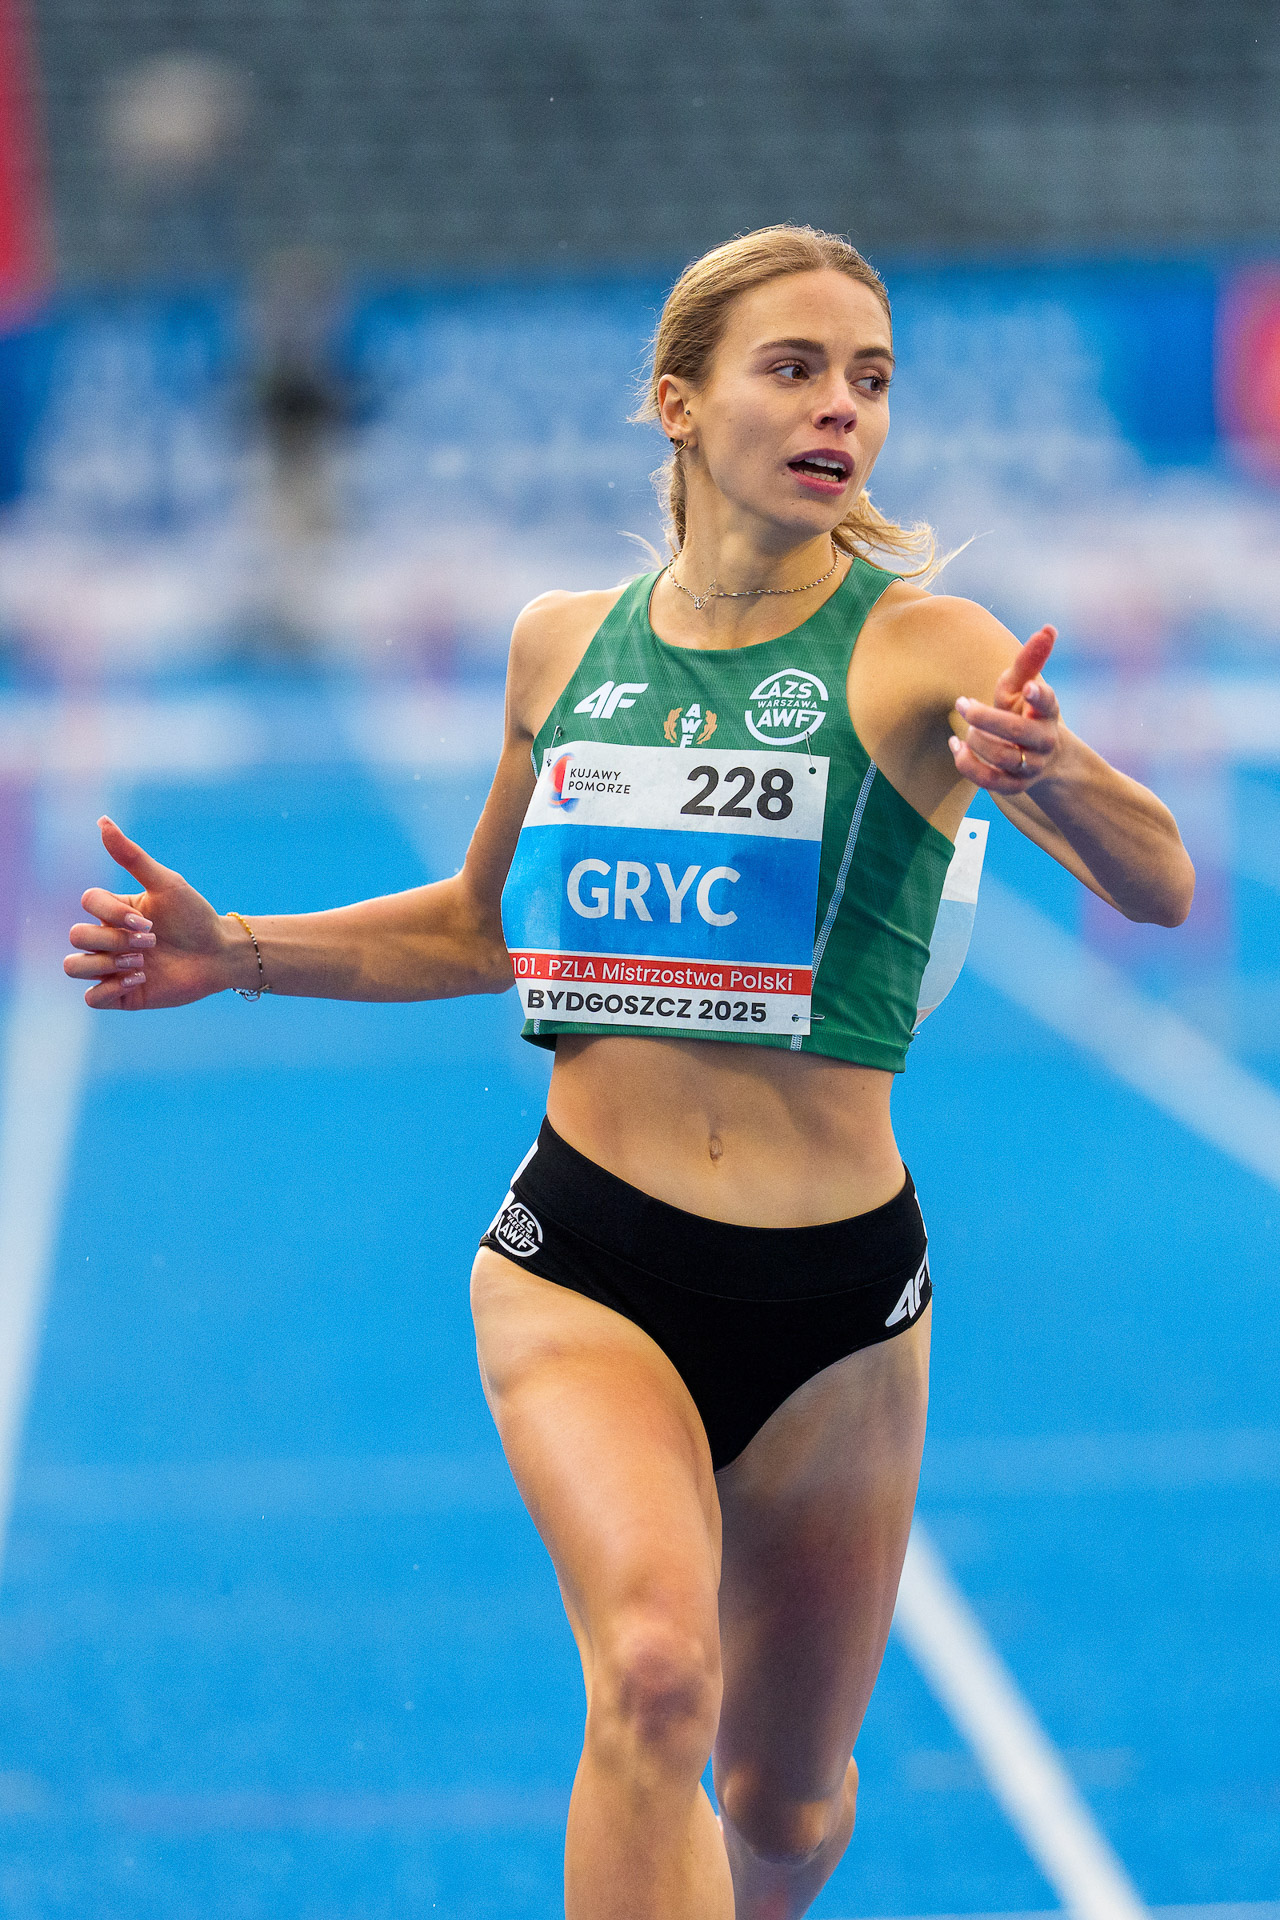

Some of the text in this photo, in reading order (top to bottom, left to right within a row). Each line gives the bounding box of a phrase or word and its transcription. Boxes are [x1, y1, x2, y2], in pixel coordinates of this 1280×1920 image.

[573, 680, 649, 719] 4F
[767, 680, 813, 699] AZS
[757, 699, 819, 710] WARSZAWA
[755, 709, 816, 729] AWF
[568, 780, 631, 795] POMORZE
[569, 768, 622, 782] KUJAWY
[680, 765, 794, 821] 228
[566, 858, 741, 927] GRYC
[512, 957, 793, 991] 101. PZLA Mistrzostwa Polski
[527, 989, 767, 1023] BYDGOSZCZ 2025
[512, 1208, 536, 1234] AZS
[500, 1224, 531, 1250] AWF
